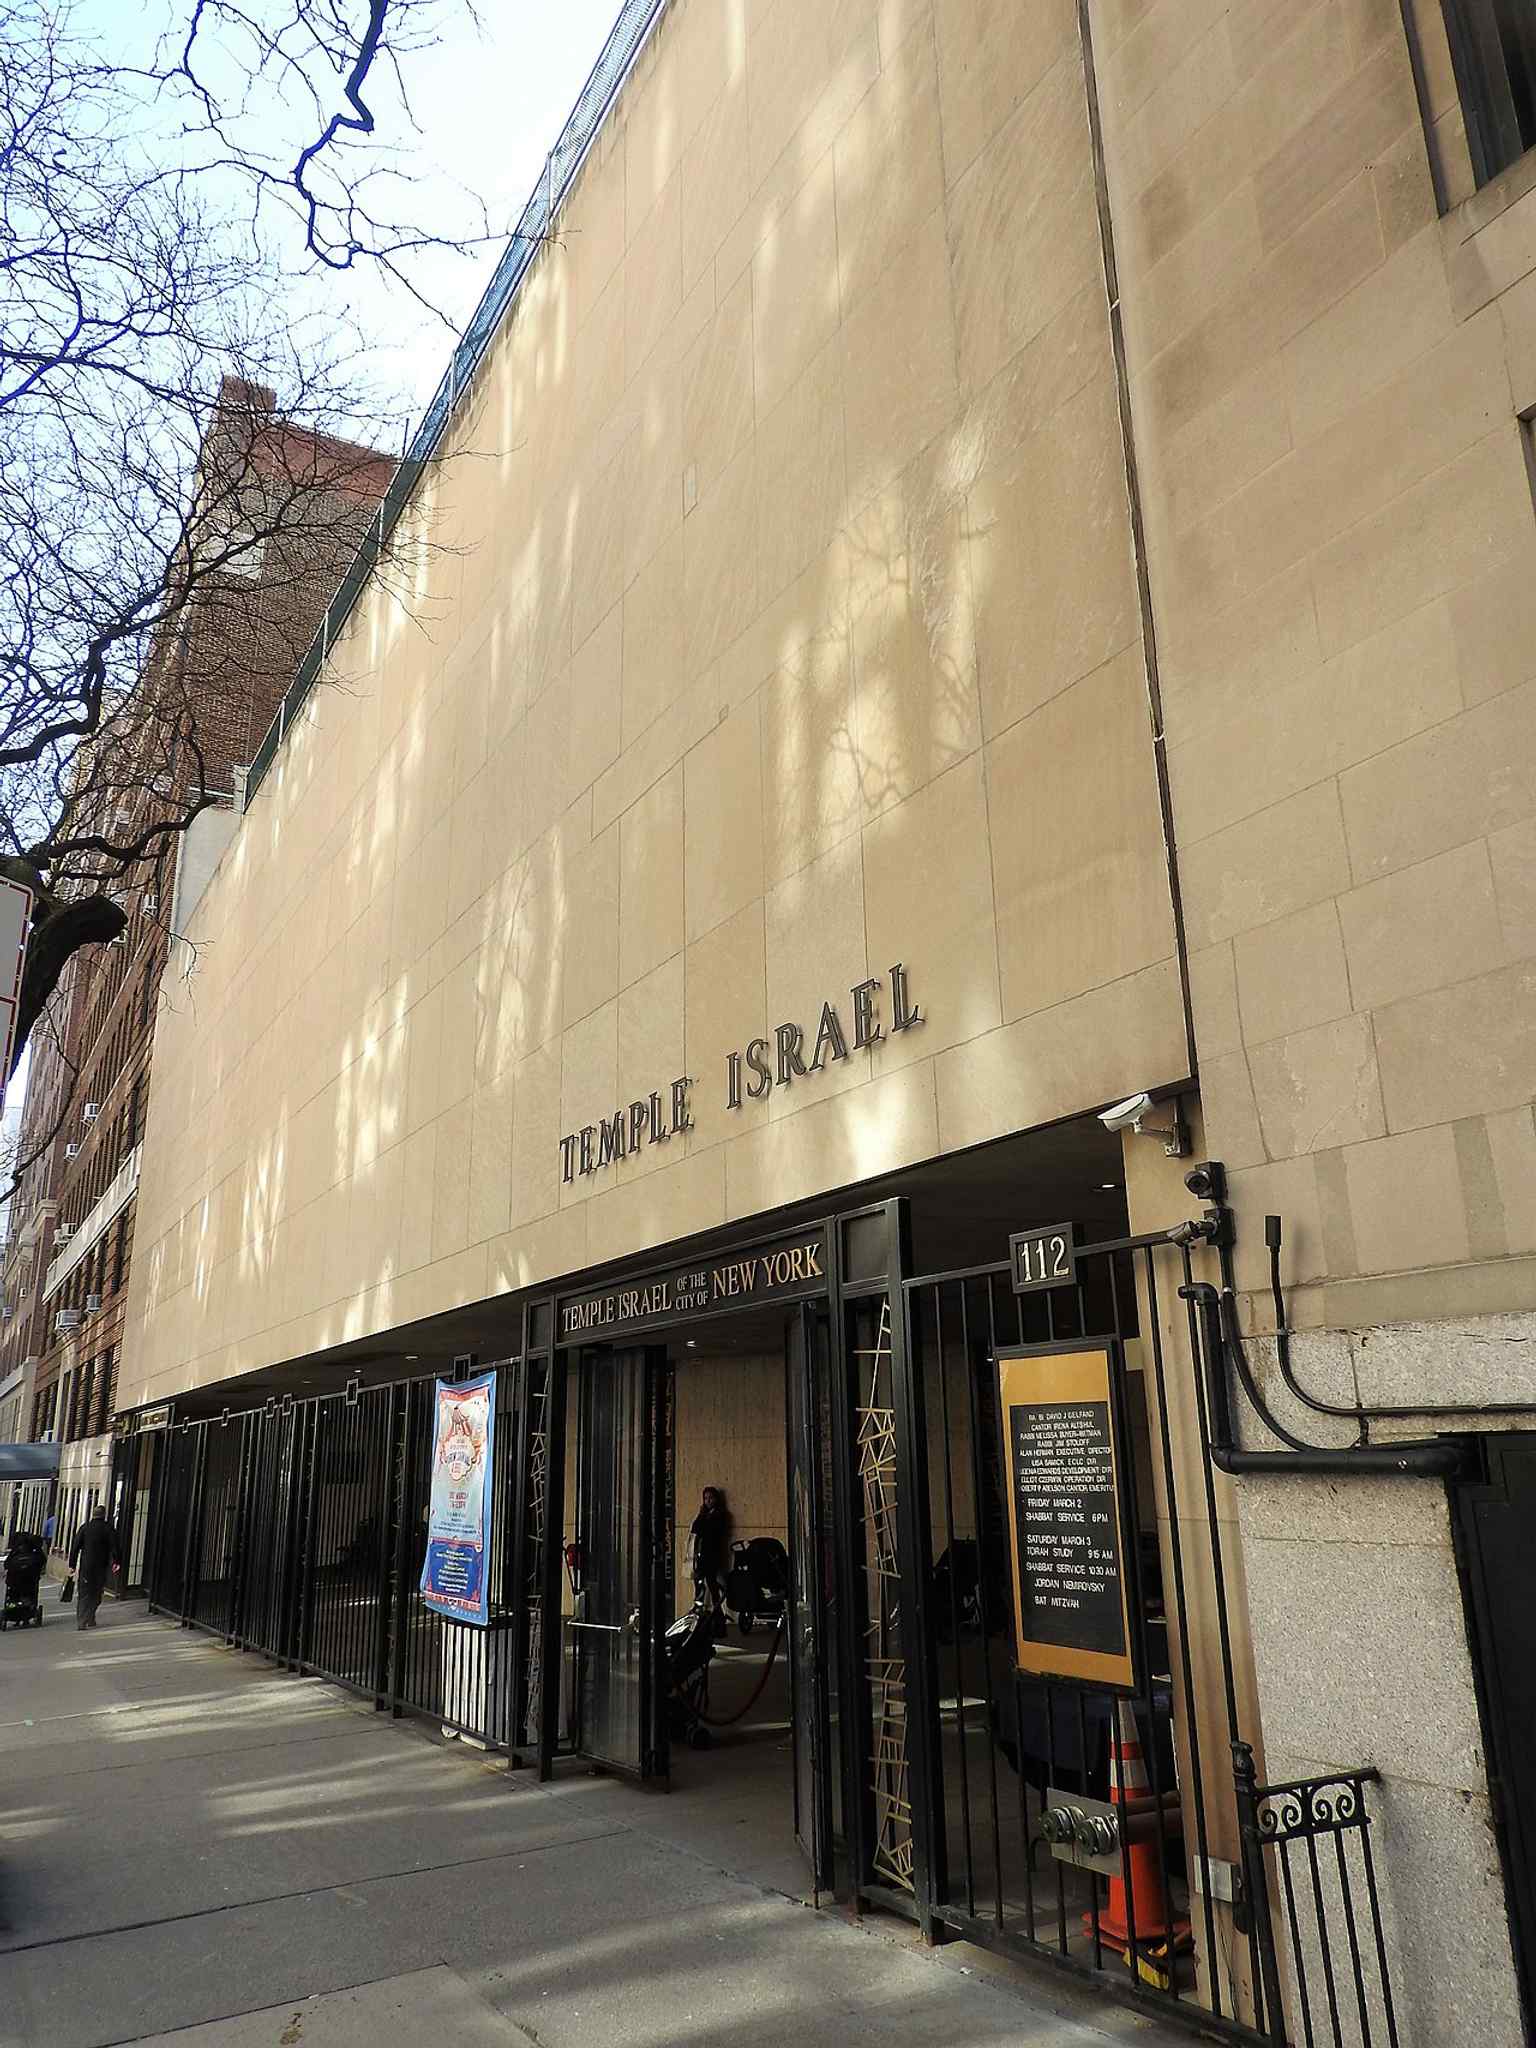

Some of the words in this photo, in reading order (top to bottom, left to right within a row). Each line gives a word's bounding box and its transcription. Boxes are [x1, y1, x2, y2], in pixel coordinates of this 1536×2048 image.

[559, 1076, 694, 1183] TEMPLE
[726, 962, 925, 1110] ISRAEL
[1022, 1236, 1069, 1281] 112
[712, 1259, 759, 1299] NEW
[762, 1243, 824, 1287] YORK
[676, 1277, 688, 1291] OF
[689, 1271, 707, 1289] THE
[563, 1296, 614, 1332] TEMPLE
[617, 1282, 672, 1320] ISRAEL
[675, 1294, 695, 1311] CITY
[697, 1289, 708, 1306] OF
[1027, 1498, 1051, 1508] FRIDAY
[1052, 1498, 1076, 1508] MARCH
[1025, 1511, 1054, 1521] SHABBAT
[1057, 1512, 1085, 1522] SERVICE
[1026, 1534, 1059, 1545] SATURDAY
[1060, 1535, 1086, 1545] MARCH
[1086, 1536, 1092, 1546] 3
[1026, 1546, 1049, 1556] TORAH
[1052, 1547, 1074, 1557] STUDY
[1101, 1549, 1114, 1560] AM
[1026, 1561, 1054, 1572] SHABBAT
[1056, 1563, 1086, 1575] SERVICE
[1105, 1567, 1117, 1576] AM
[1034, 1578, 1060, 1588] JORDAN
